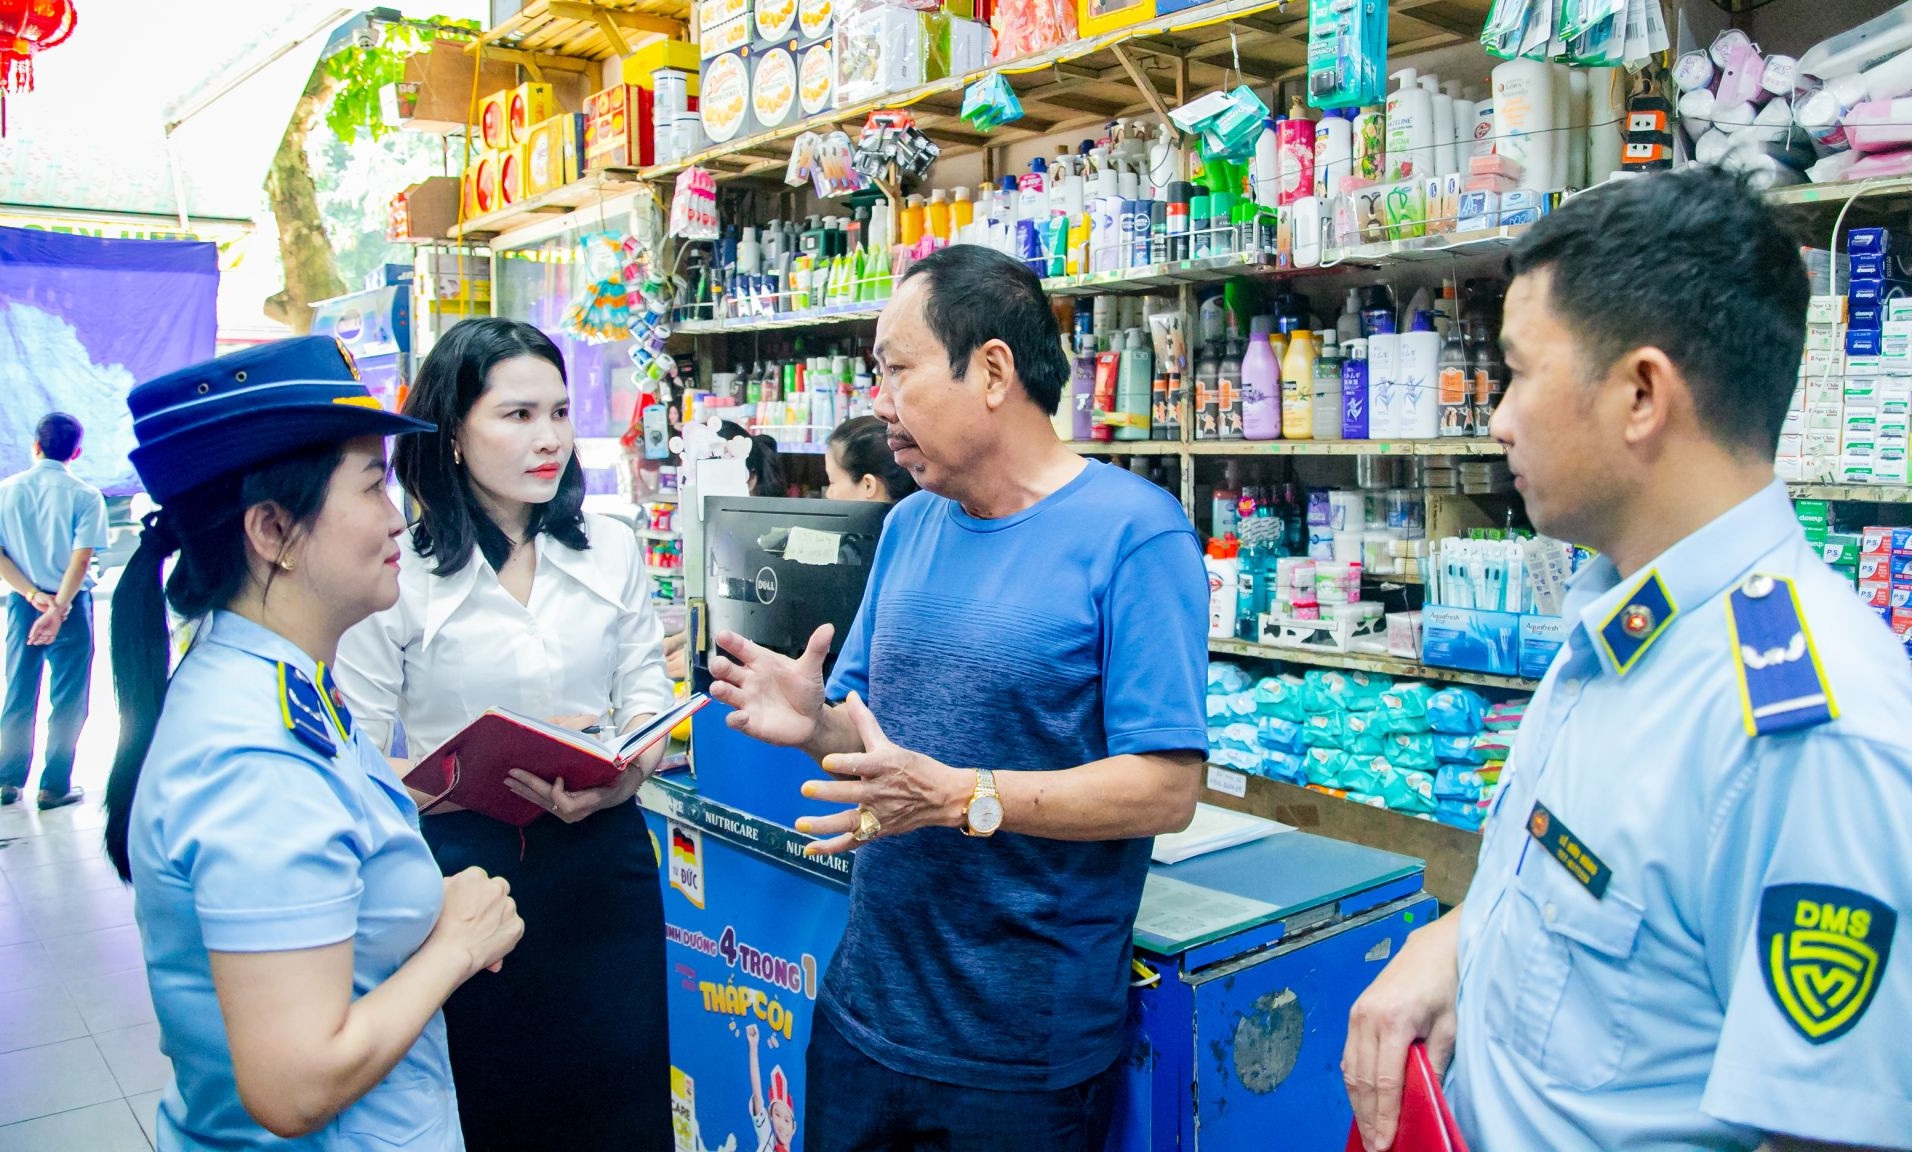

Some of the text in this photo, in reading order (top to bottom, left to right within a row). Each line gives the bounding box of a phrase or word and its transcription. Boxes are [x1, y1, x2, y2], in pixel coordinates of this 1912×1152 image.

[1430, 611, 1460, 621] Aquafresh
[1526, 622, 1559, 632] Aquafresh
[705, 811, 759, 841] NUTRICARE
[1794, 900, 1872, 939] DMS
[665, 924, 681, 941] INH
[720, 926, 738, 967] 4
[738, 943, 801, 993] TRONG
[802, 953, 817, 1000] 1
